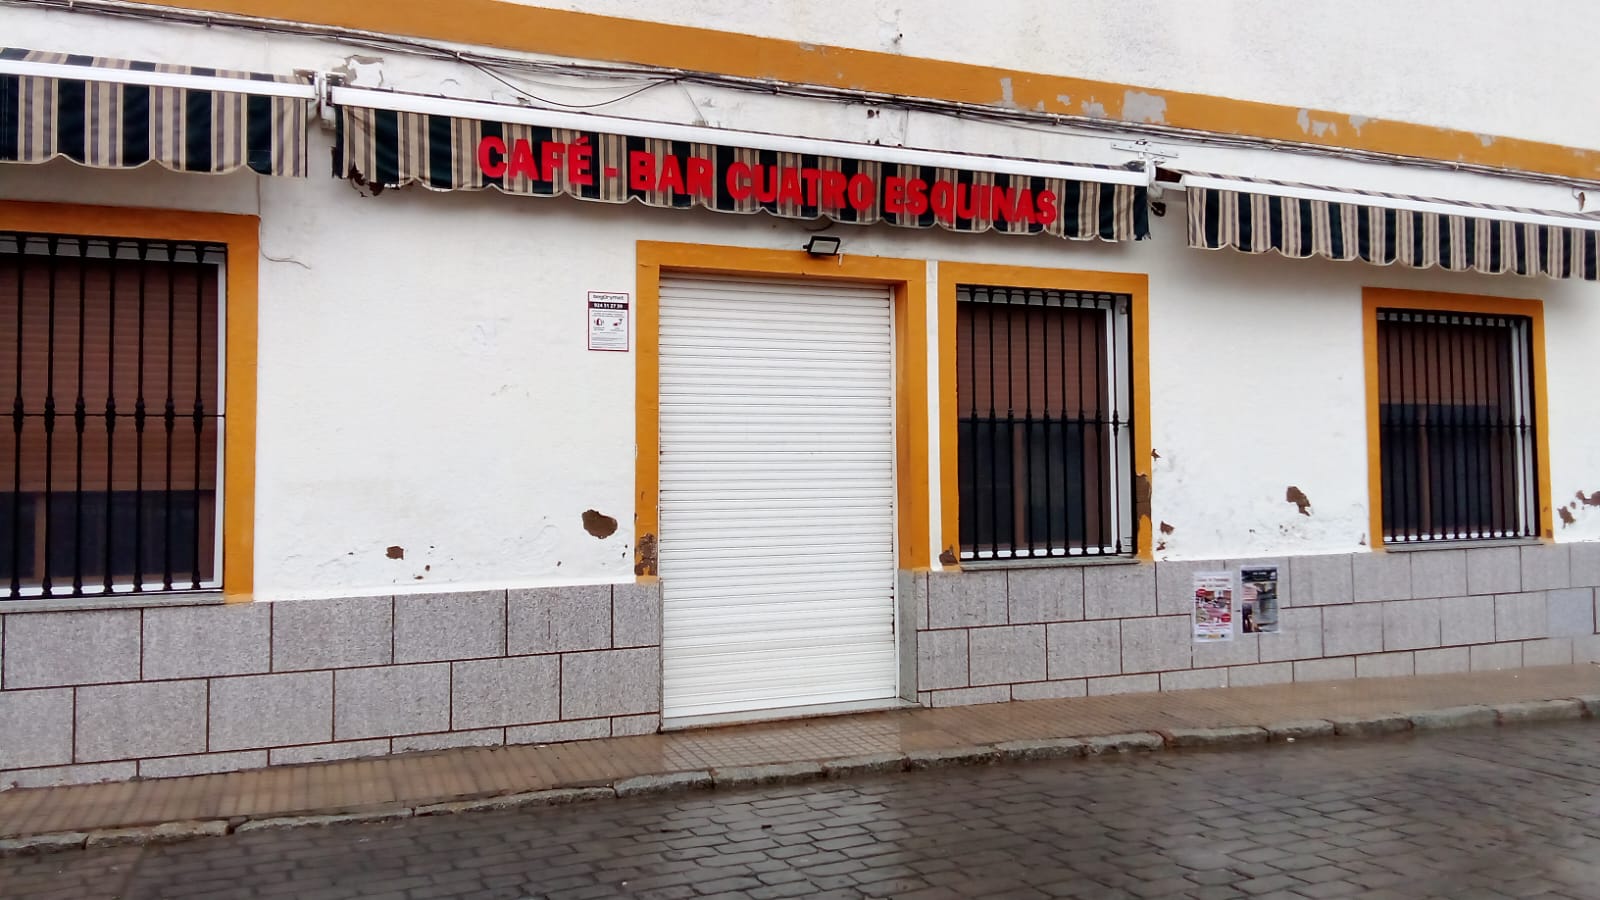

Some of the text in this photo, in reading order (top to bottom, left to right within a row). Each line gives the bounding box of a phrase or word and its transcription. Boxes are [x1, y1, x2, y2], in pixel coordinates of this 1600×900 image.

[478, 136, 593, 186] CAFÉ
[631, 151, 714, 199] BAR
[726, 161, 874, 211] CUATRO
[885, 174, 1057, 225] ESQUINAS
